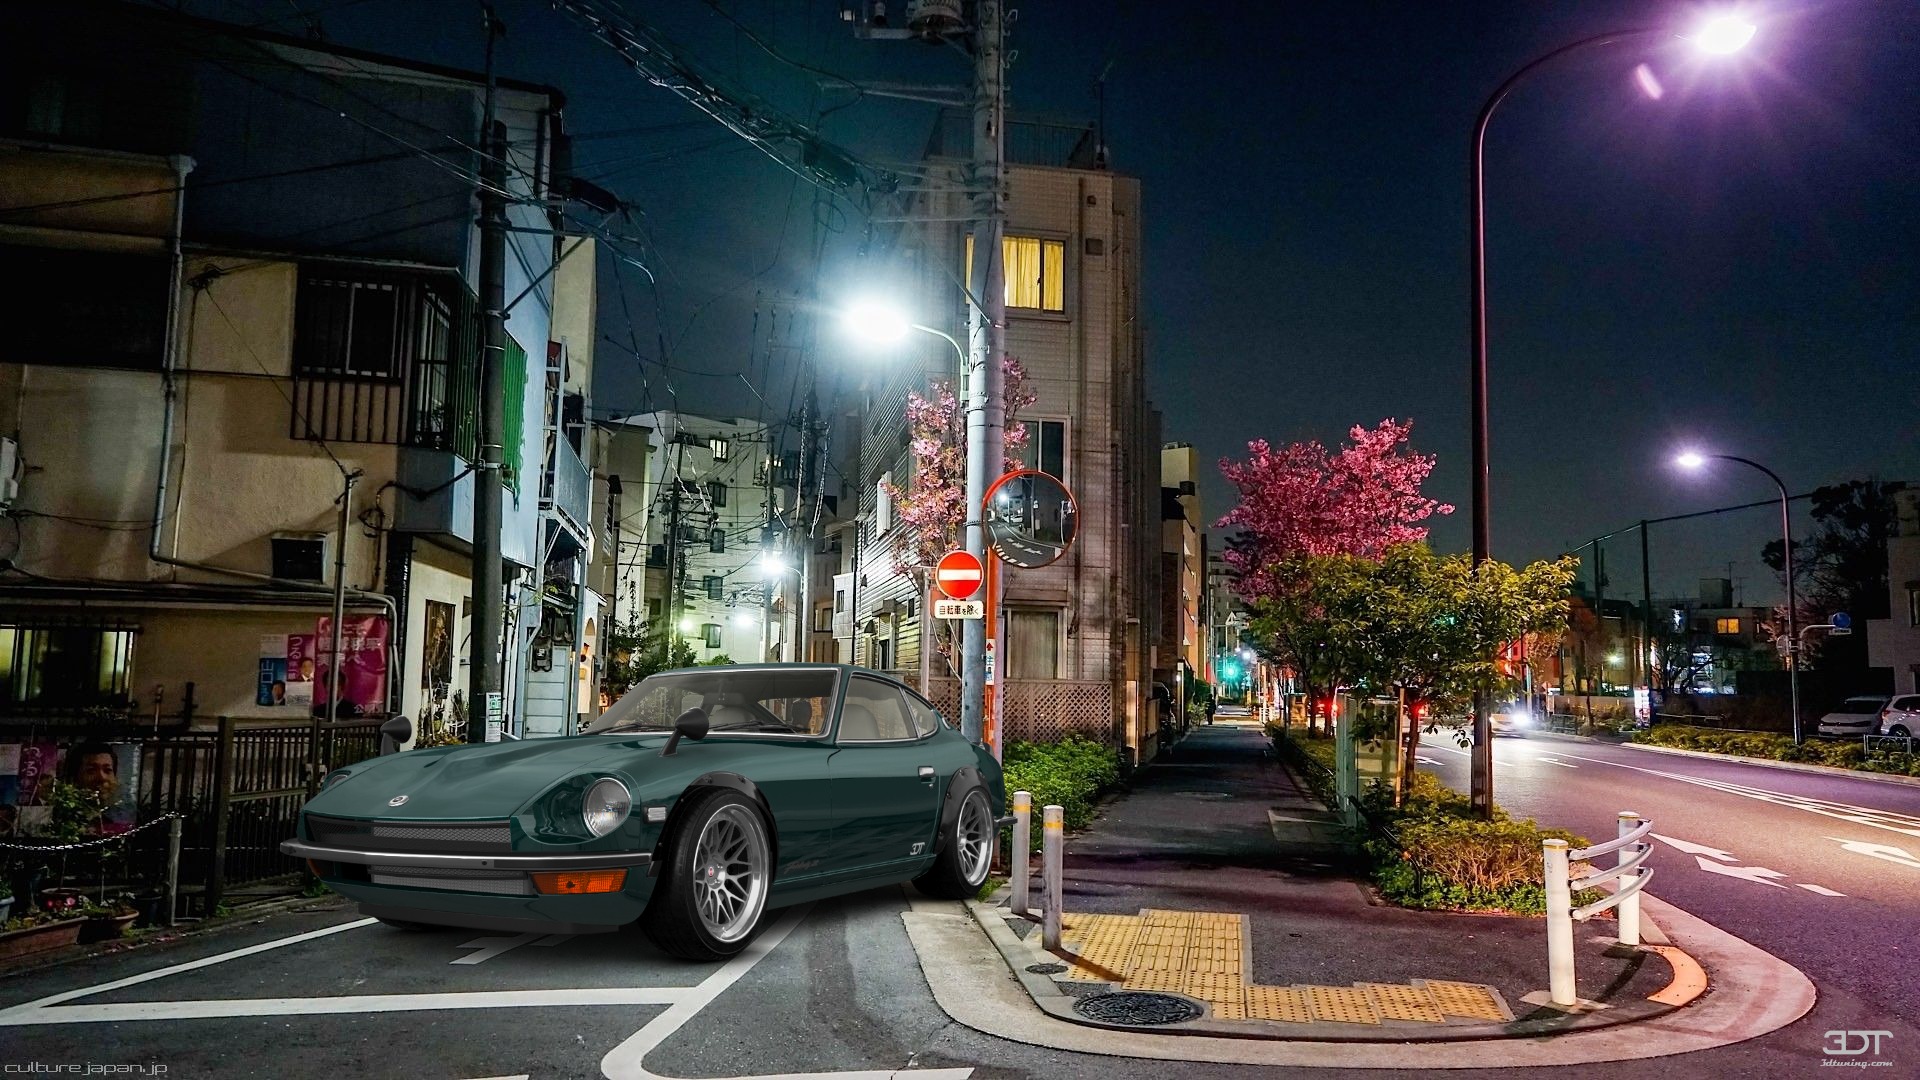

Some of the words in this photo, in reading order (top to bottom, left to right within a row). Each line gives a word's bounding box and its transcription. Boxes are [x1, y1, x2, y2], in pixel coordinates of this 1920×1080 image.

[939, 604, 979, 616] 自転車を除く
